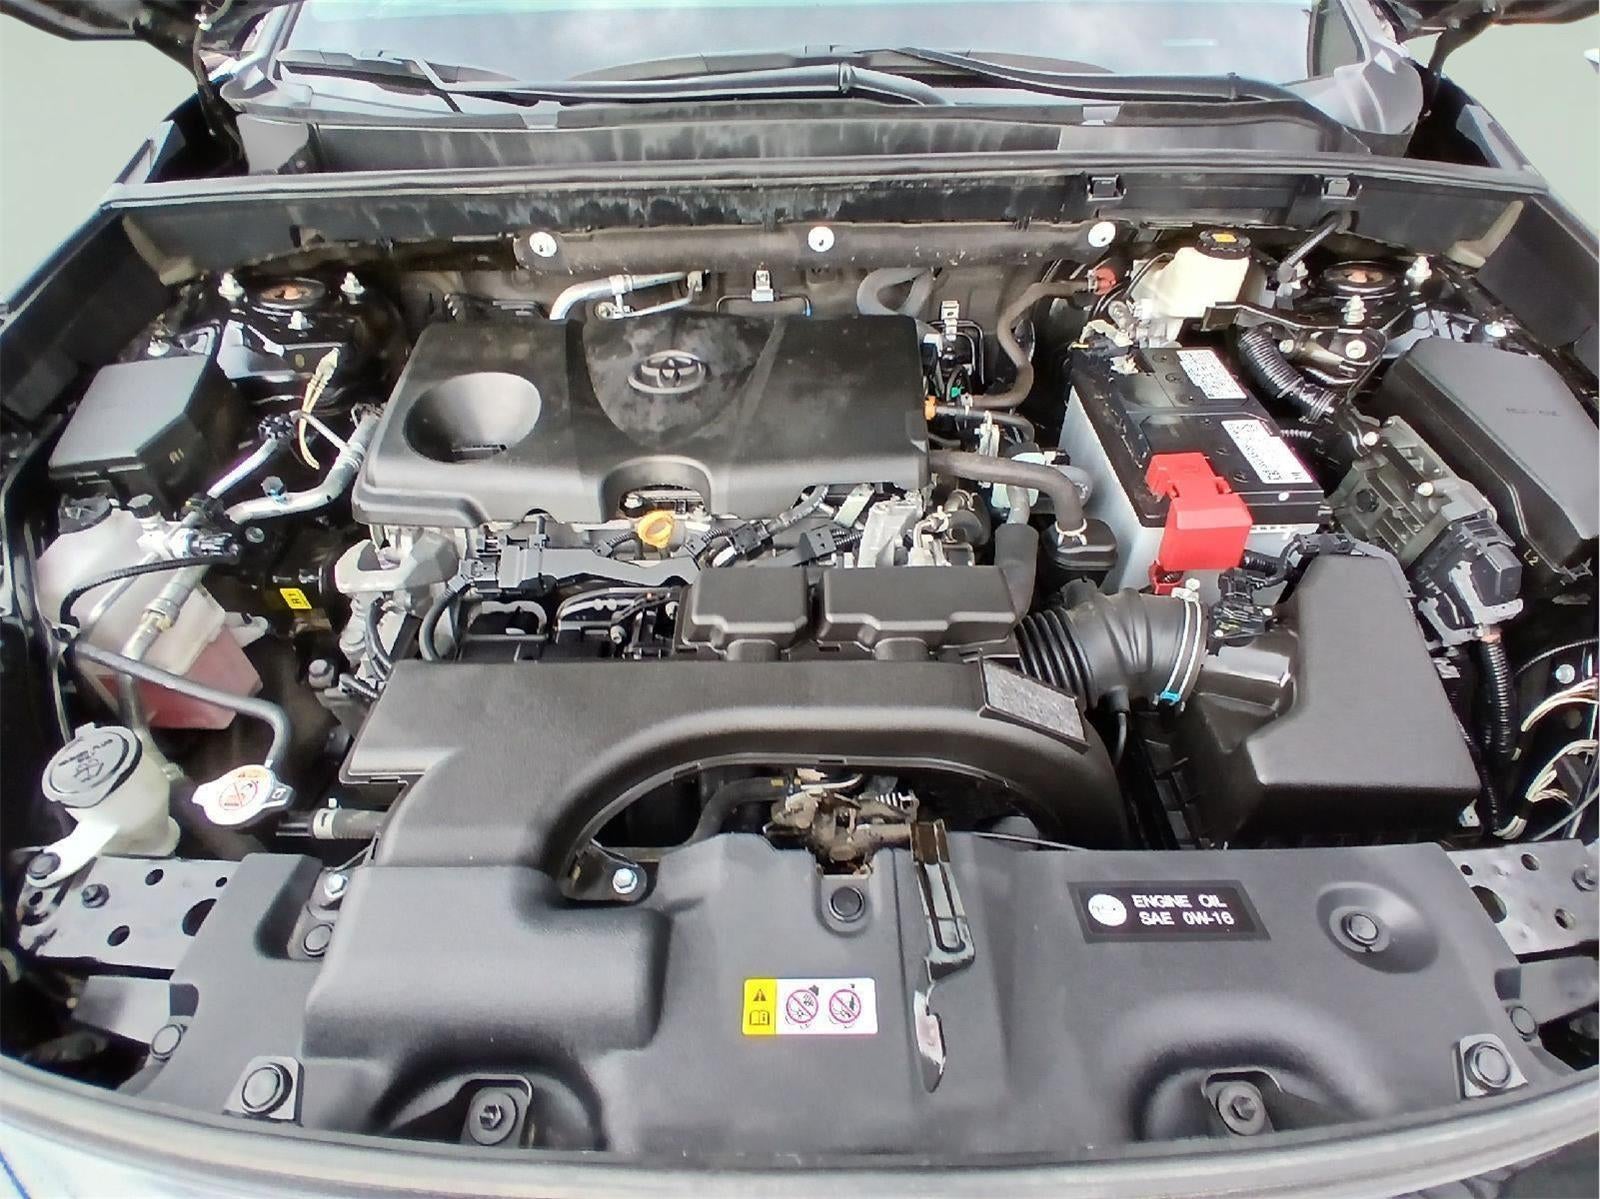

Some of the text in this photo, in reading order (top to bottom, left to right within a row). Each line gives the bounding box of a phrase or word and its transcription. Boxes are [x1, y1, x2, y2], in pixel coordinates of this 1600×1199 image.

[1131, 894, 1192, 908] ENGINE
[1198, 894, 1227, 908] OIL
[1139, 912, 1175, 925] SAE
